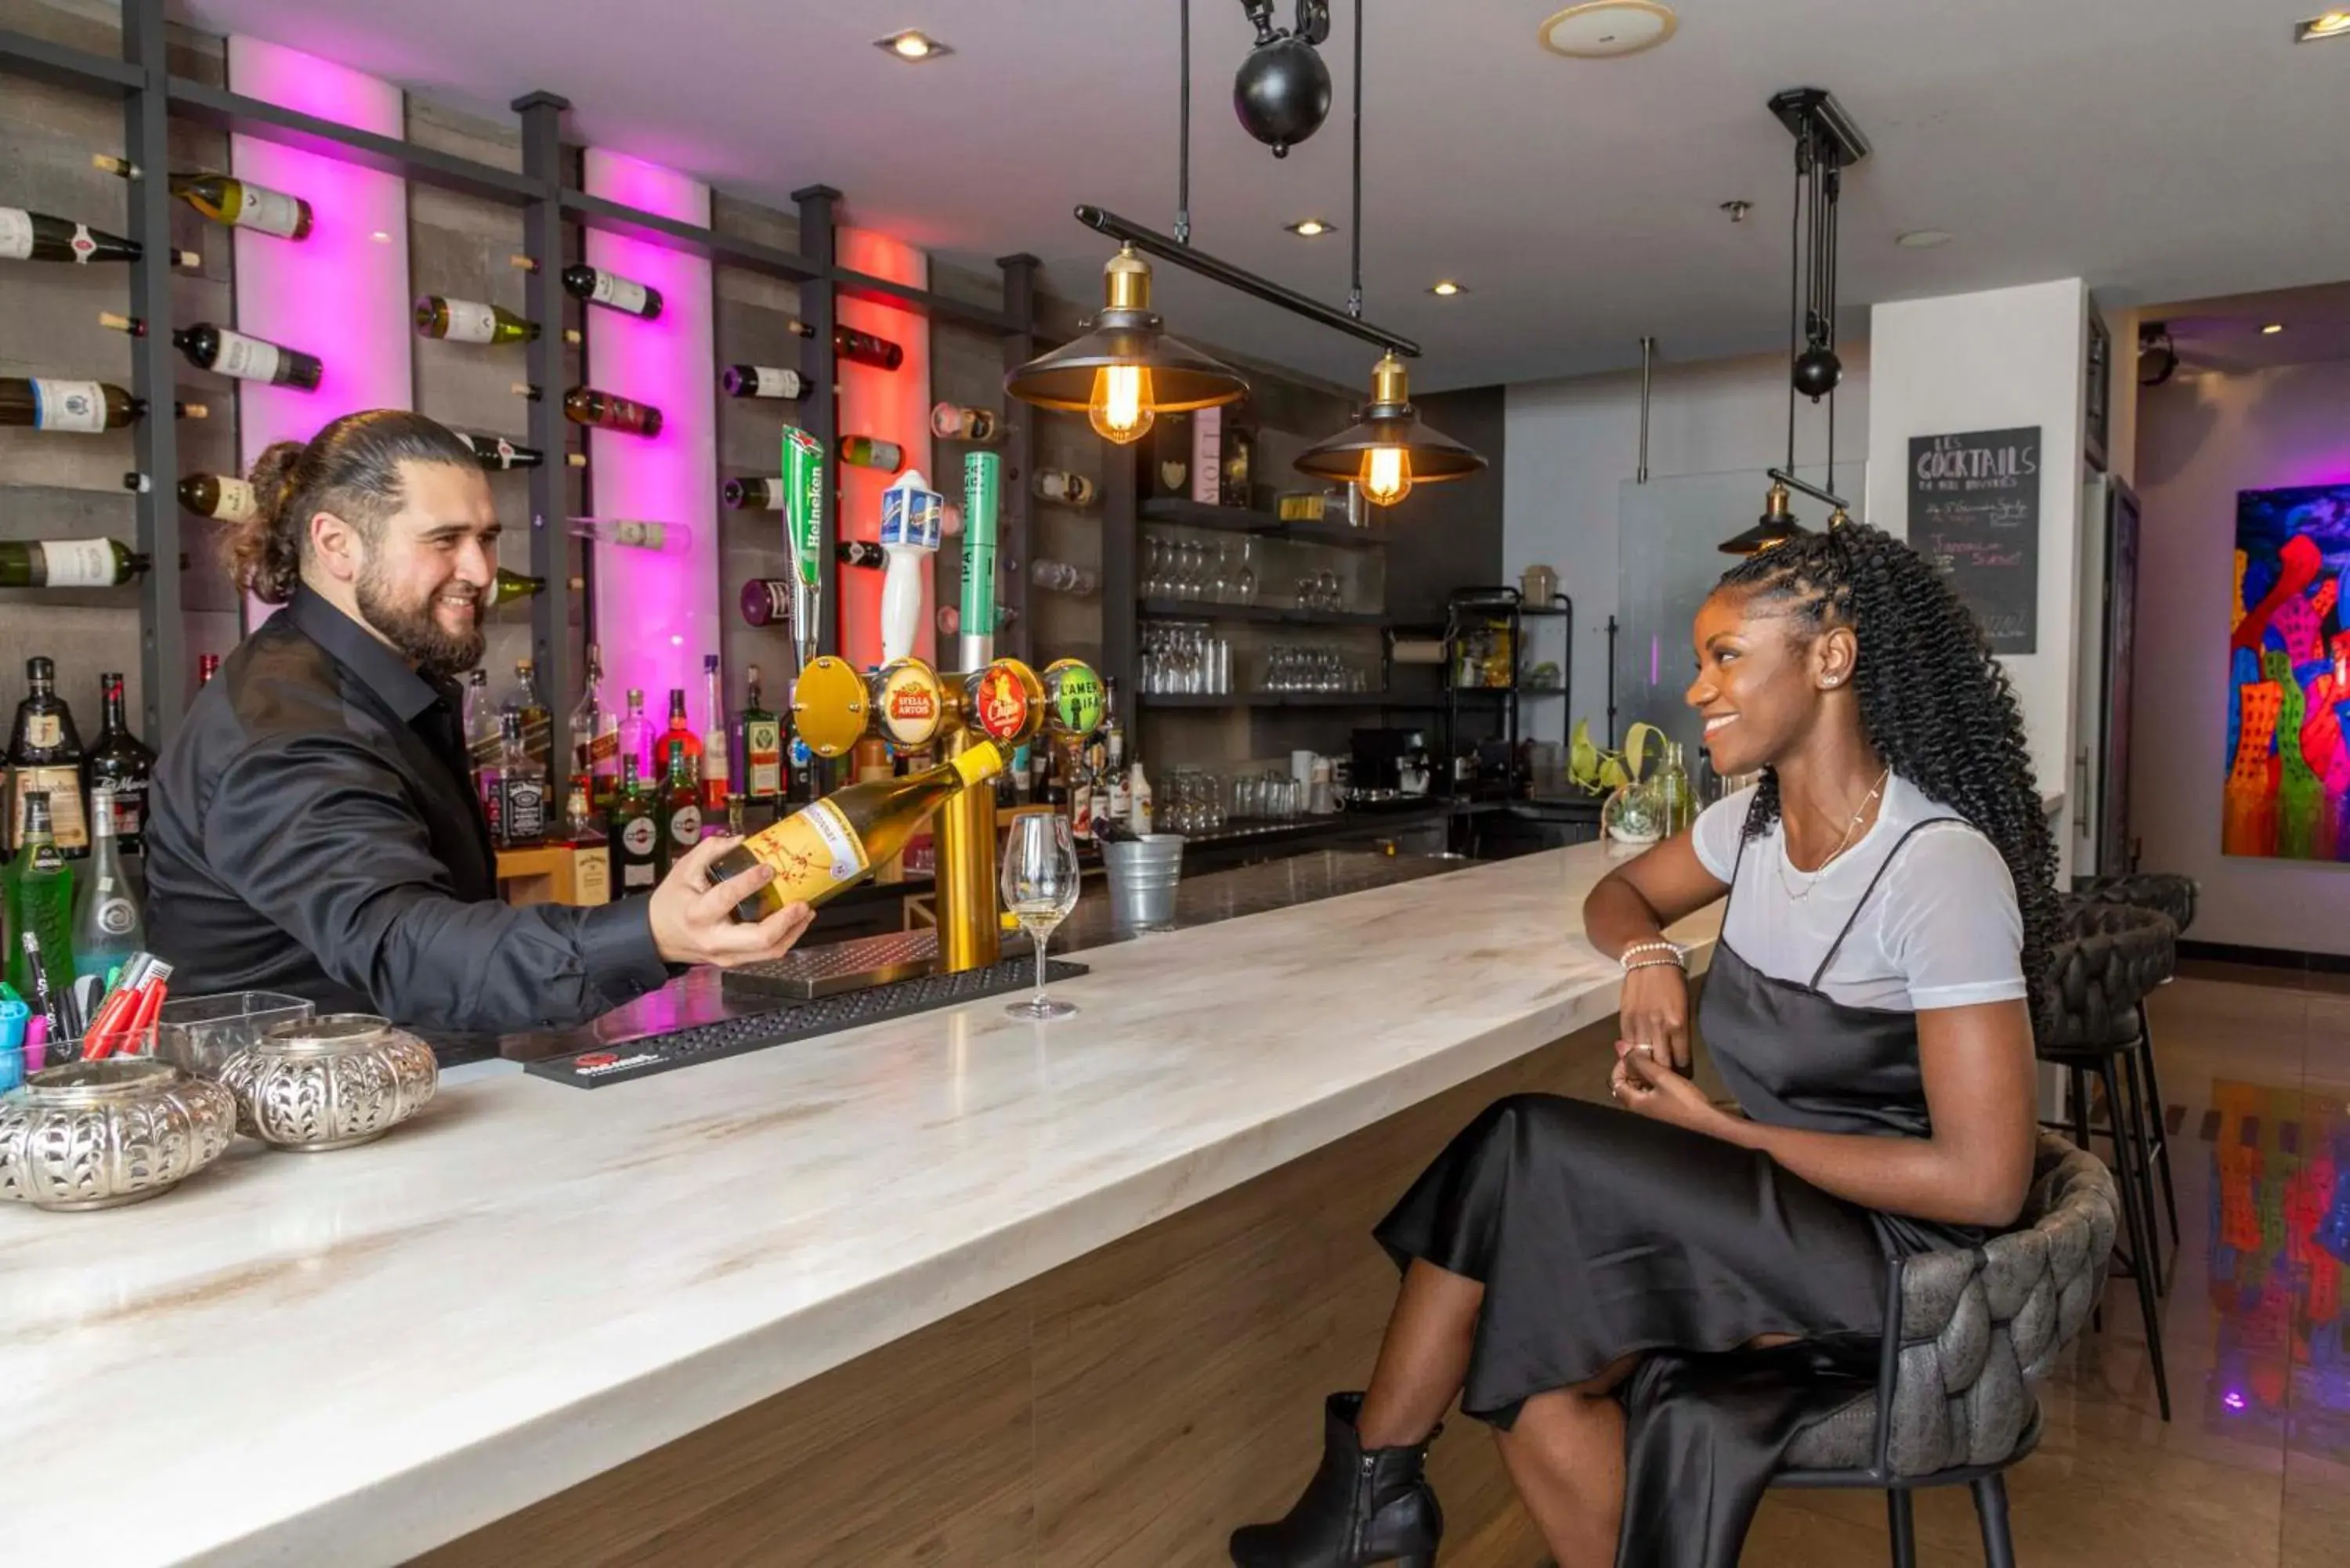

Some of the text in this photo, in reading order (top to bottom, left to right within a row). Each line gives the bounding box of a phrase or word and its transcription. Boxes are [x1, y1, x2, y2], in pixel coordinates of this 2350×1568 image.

[1917, 445, 2037, 480] COCKTAILS
[808, 466, 822, 547] Heineken
[962, 551, 971, 583] IPA
[898, 696, 930, 706] STELLA
[898, 705, 930, 715] ARTOIS
